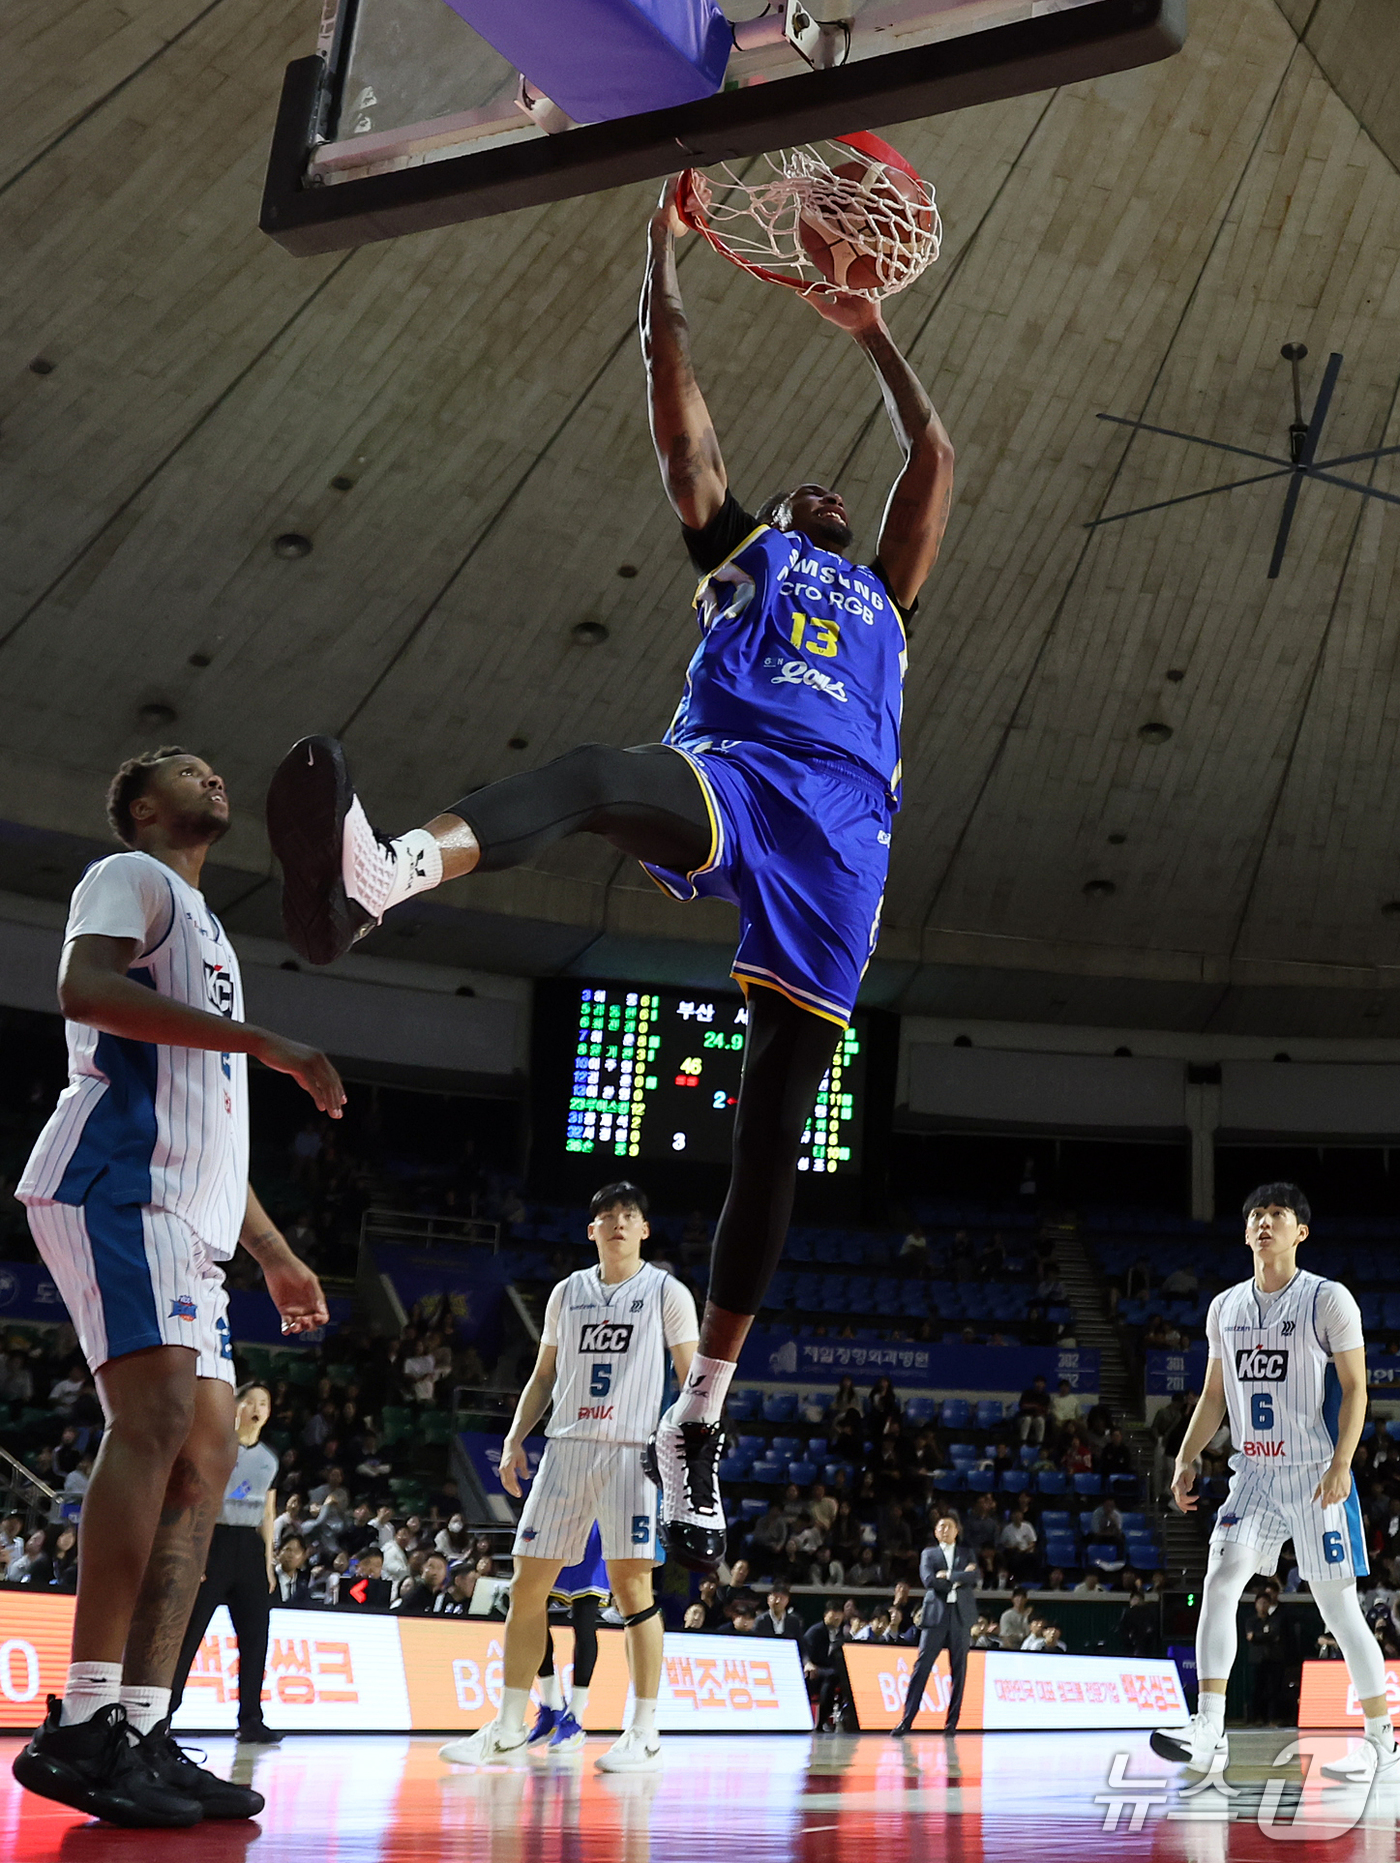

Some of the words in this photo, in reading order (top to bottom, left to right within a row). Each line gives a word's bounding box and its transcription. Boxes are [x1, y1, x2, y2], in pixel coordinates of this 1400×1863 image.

[828, 591, 874, 626] RGB
[789, 611, 840, 658] 13
[205, 963, 234, 1018] KC
[676, 1001, 715, 1022] 부산
[703, 1031, 744, 1050] 24.9
[680, 1057, 702, 1075] 46
[631, 1102, 646, 1116] 12
[713, 1090, 726, 1108] 2
[631, 1116, 641, 1129] 2
[672, 1132, 686, 1151] 3
[580, 1323, 629, 1351] KCC
[1238, 1347, 1284, 1379] KCC
[590, 1363, 612, 1397] 5
[1250, 1393, 1274, 1430] 6
[1243, 1440, 1286, 1457] BNK
[631, 1515, 650, 1544] 5
[1322, 1530, 1345, 1564] 6
[662, 1656, 779, 1710] 백조씽크
